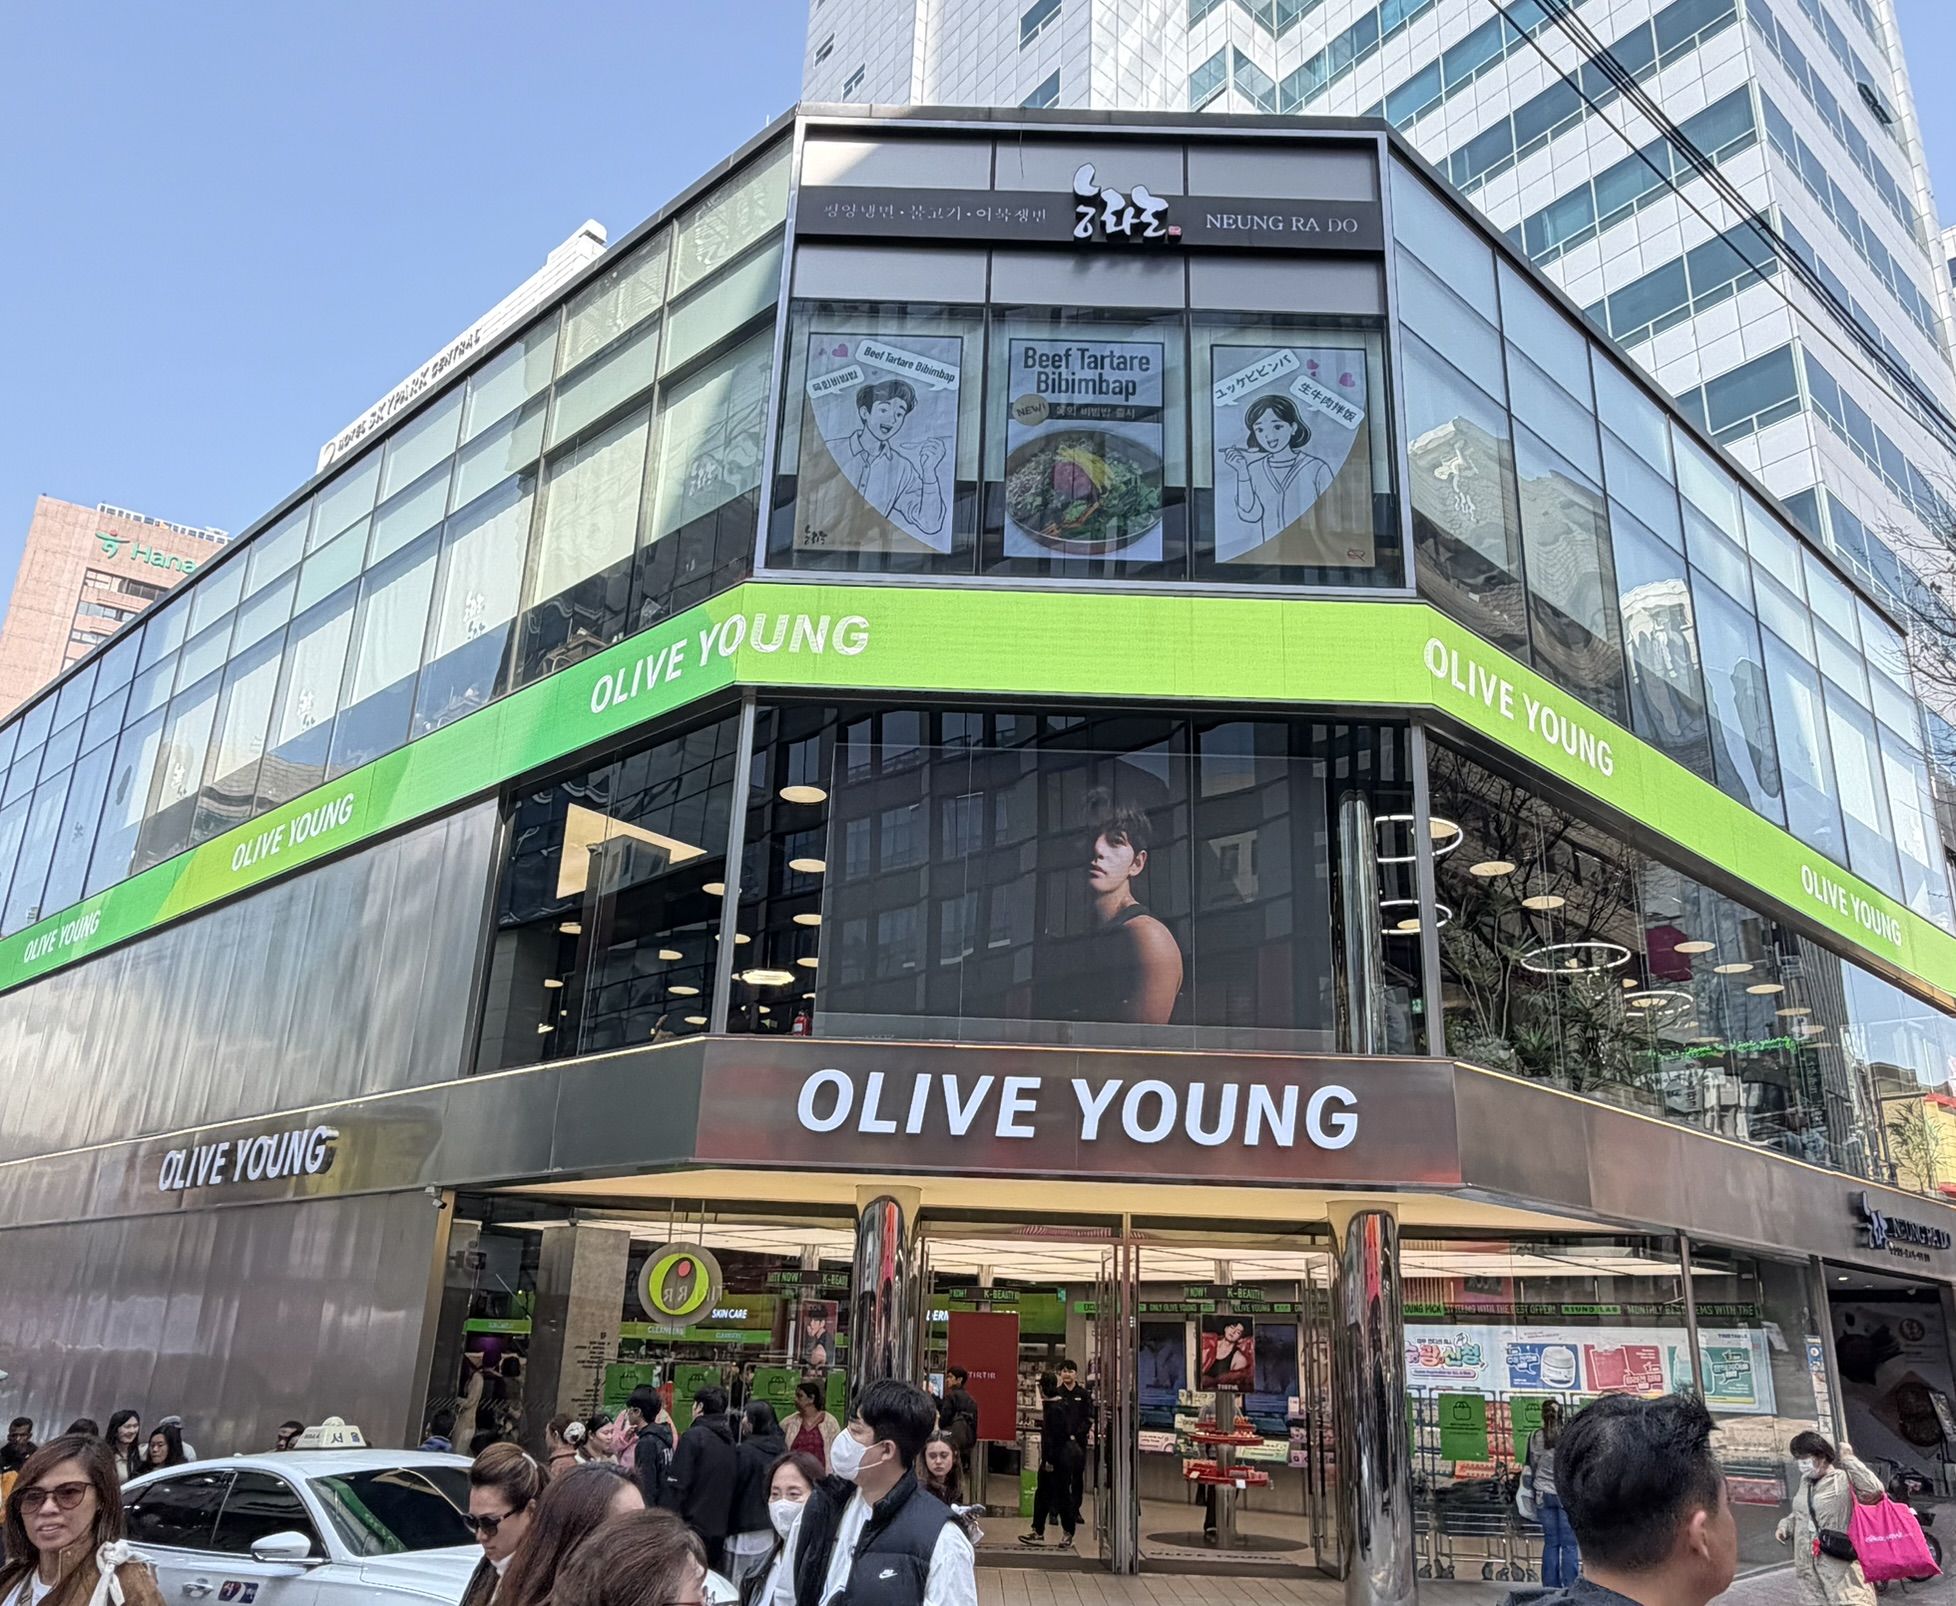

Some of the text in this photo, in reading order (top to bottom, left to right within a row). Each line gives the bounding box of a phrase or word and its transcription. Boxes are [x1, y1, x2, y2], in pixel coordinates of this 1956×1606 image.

[1206, 213, 1358, 233] NEUNG RA DO
[864, 346, 956, 384] Beef Tartare Bibimbap
[1023, 347, 1150, 372] Beef Tartare
[1036, 371, 1137, 402] Bibimbap
[1298, 382, 1357, 423] 生牛肉拌饭
[1016, 403, 1046, 417] NEW!
[130, 542, 197, 575] Hana
[590, 613, 870, 714] OLIVE YOUNG
[1424, 637, 1614, 777] OLIVE YOUNG
[231, 792, 355, 872] OLIVE YOUNG
[1801, 864, 1902, 947] OLIVE YOUNG
[24, 909, 102, 964] OLIVE YOUNG
[797, 1069, 1358, 1150] OLIVE YOUNG
[159, 1125, 331, 1192] OLIVE YOUNG
[711, 1309, 748, 1319] SKIN CARE
[1403, 1304, 1442, 1314] OUNG PICK
[1696, 1304, 1713, 1315] EMS
[968, 1371, 996, 1380] TIRTIR
